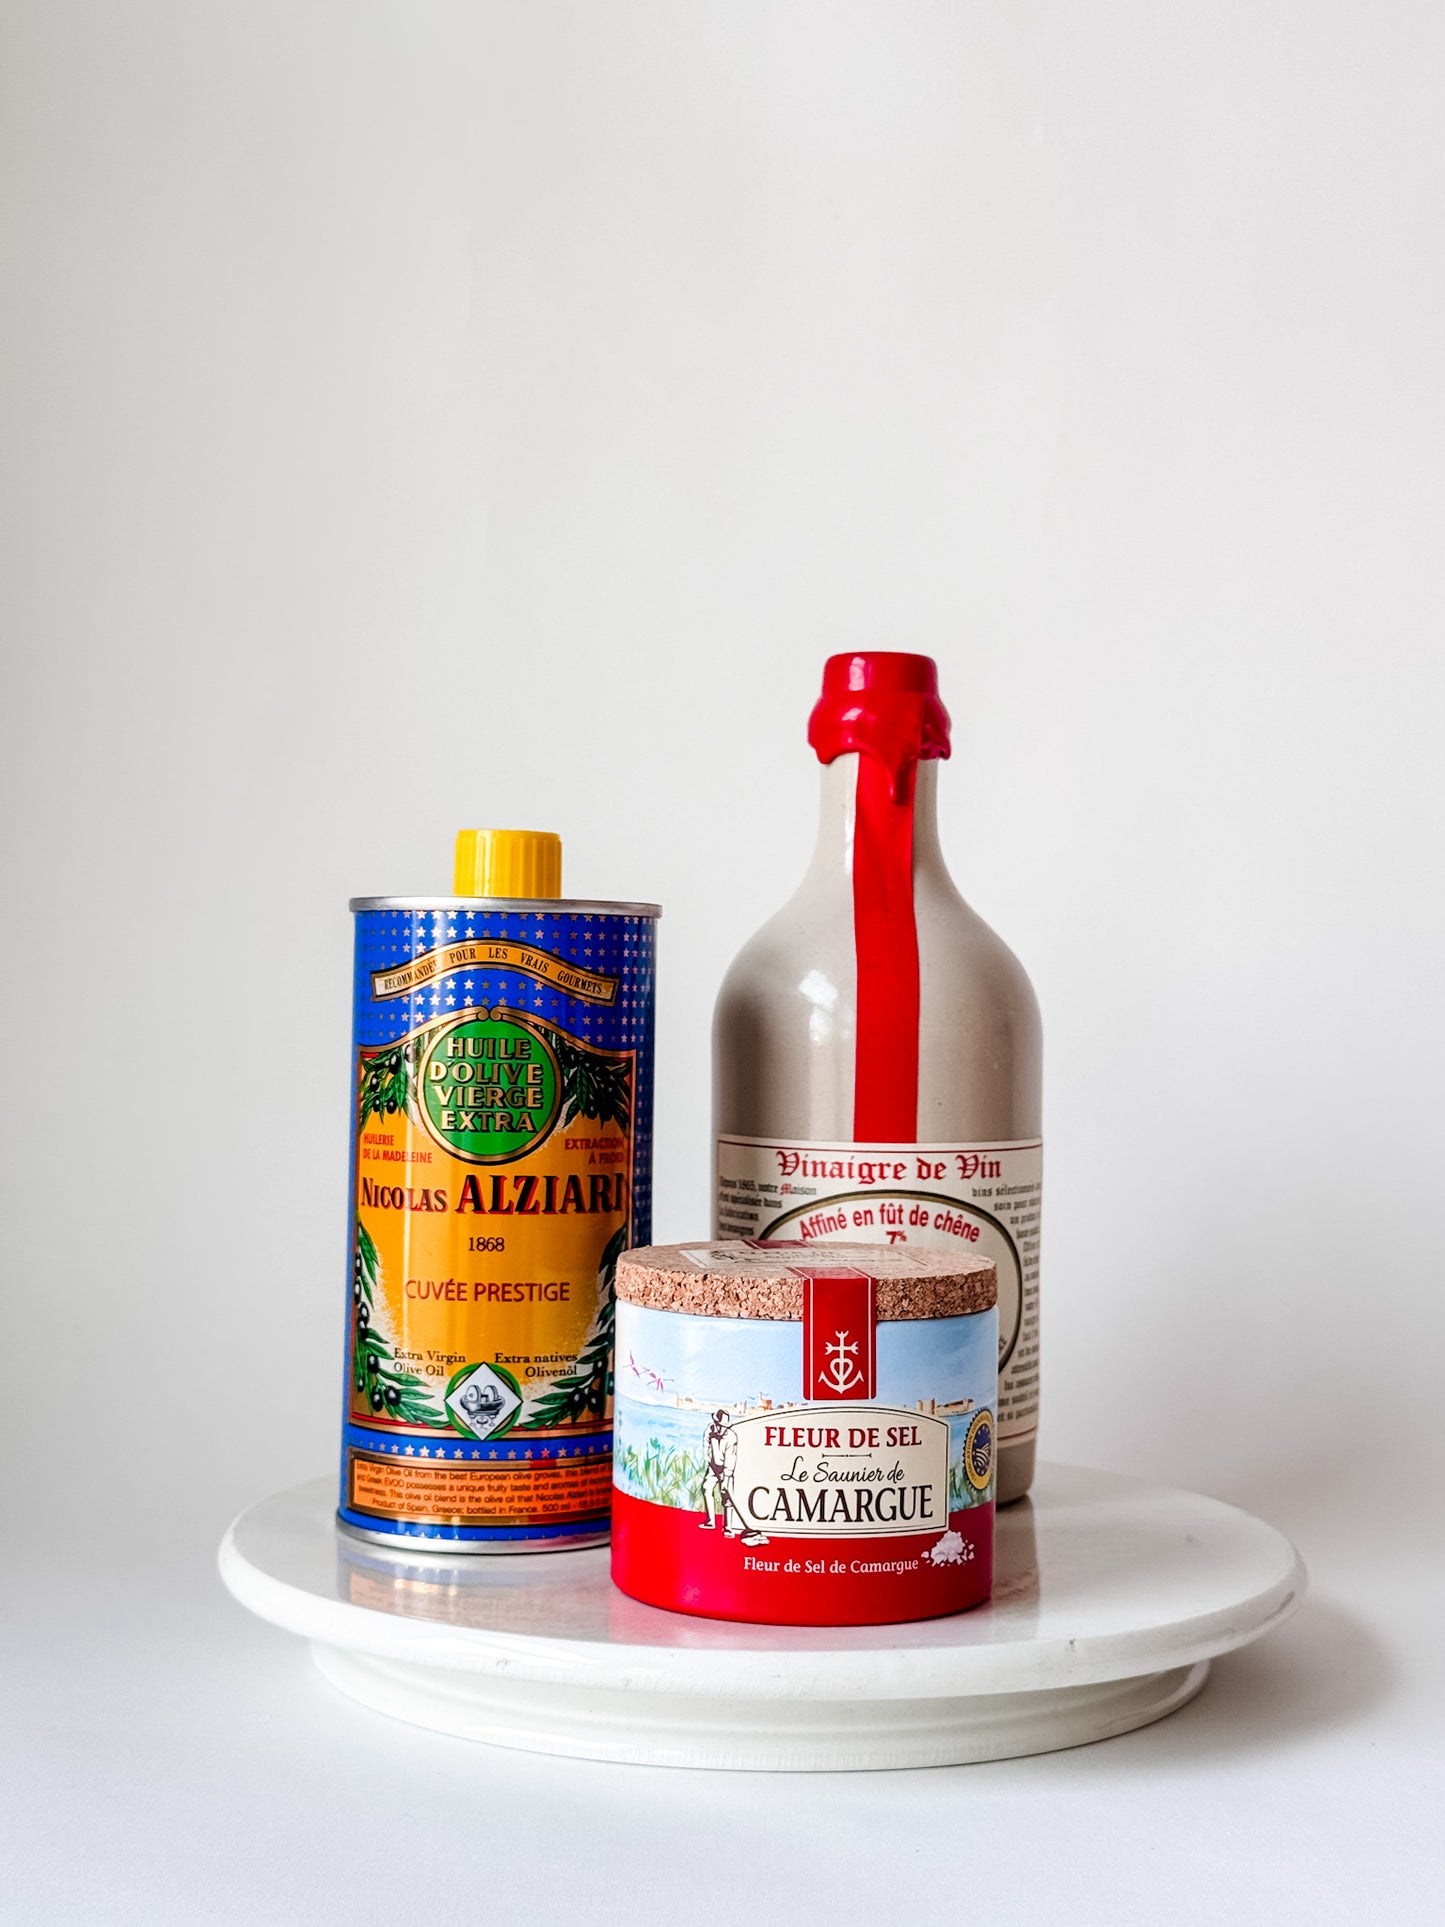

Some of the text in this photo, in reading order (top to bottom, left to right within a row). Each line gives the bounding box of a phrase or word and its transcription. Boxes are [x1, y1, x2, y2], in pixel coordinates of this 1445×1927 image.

[449, 947, 476, 964] POUR
[488, 947, 508, 959] LES
[520, 952, 550, 973] VRAIS
[557, 971, 602, 994] GOURMETS
[446, 1037, 532, 1060] HUILE
[429, 1060, 544, 1084] D'OLIVE
[433, 1085, 543, 1110] VIERGE
[441, 1110, 537, 1133] EXTRA
[363, 1132, 394, 1146] HUILERIE
[564, 1136, 625, 1151] EXTRACTION
[363, 1148, 433, 1164] DE LA MADELEINE
[599, 1151, 624, 1164] FROID
[776, 1150, 1002, 1184] Vinaigre de Vin
[455, 1172, 624, 1215] ALZIARI
[799, 1202, 981, 1243] Affiné en fût de chêne
[468, 1236, 505, 1252] 1868
[405, 1278, 570, 1302] CUVÉE PRESTIGE
[394, 1348, 466, 1365] Extra Virgin
[494, 1352, 578, 1364] Extra natives
[394, 1361, 445, 1376] Olive Oil
[525, 1365, 578, 1378] Olivenöl
[763, 1425, 923, 1449] FLEUR DE SEL
[386, 1465, 402, 1475] Olive
[403, 1468, 413, 1477] Oil
[415, 1469, 432, 1478] from
[434, 1470, 447, 1479] the
[449, 1471, 467, 1480] best
[469, 1471, 511, 1481] European
[513, 1471, 532, 1480] olive
[780, 1455, 905, 1484] Le Saunier de
[456, 1483, 485, 1493] unique
[747, 1483, 934, 1523] CAMARGUE
[743, 1556, 919, 1576] Fleur de Sel de Camargue
